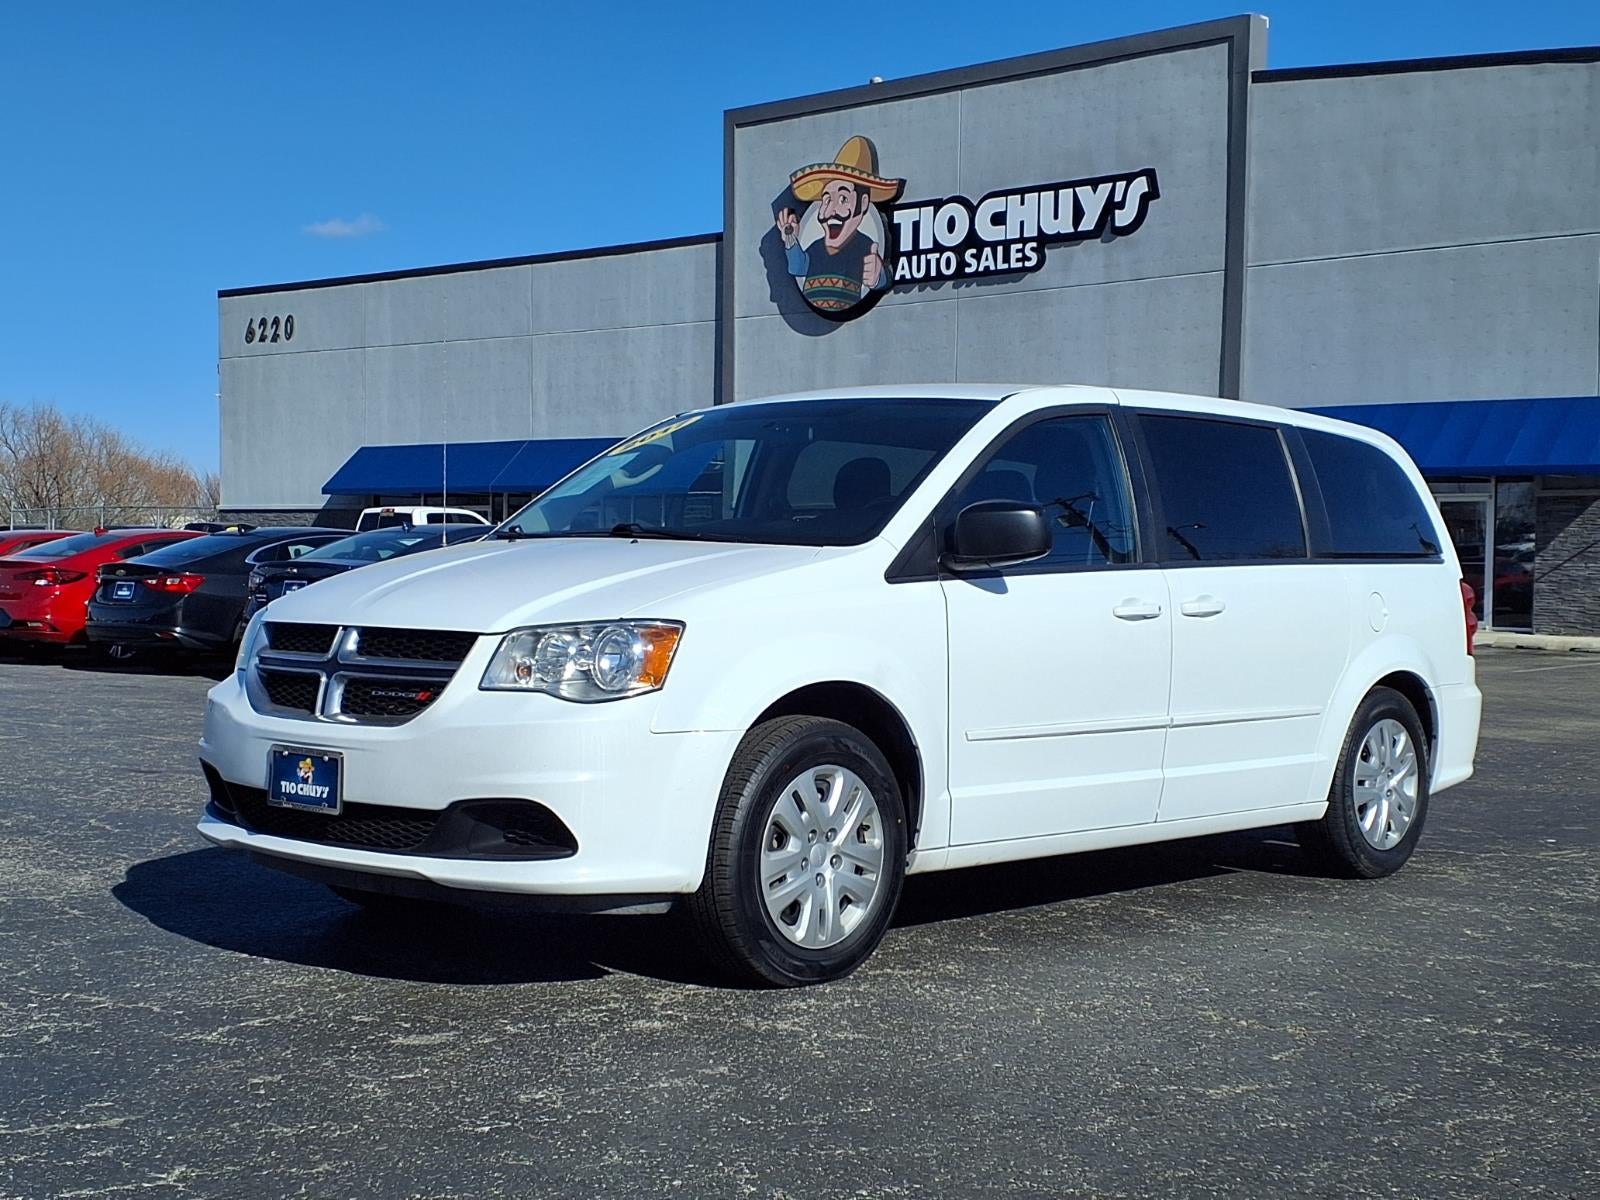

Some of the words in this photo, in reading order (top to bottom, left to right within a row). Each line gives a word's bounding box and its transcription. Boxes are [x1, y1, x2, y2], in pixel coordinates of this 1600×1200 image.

[894, 202, 970, 251] TIO
[975, 176, 1149, 241] CHUY'S
[895, 251, 957, 281] AUTO
[964, 242, 1038, 273] SALES
[245, 314, 294, 344] 6220
[371, 690, 416, 698] DODGE
[280, 781, 297, 795] TIO
